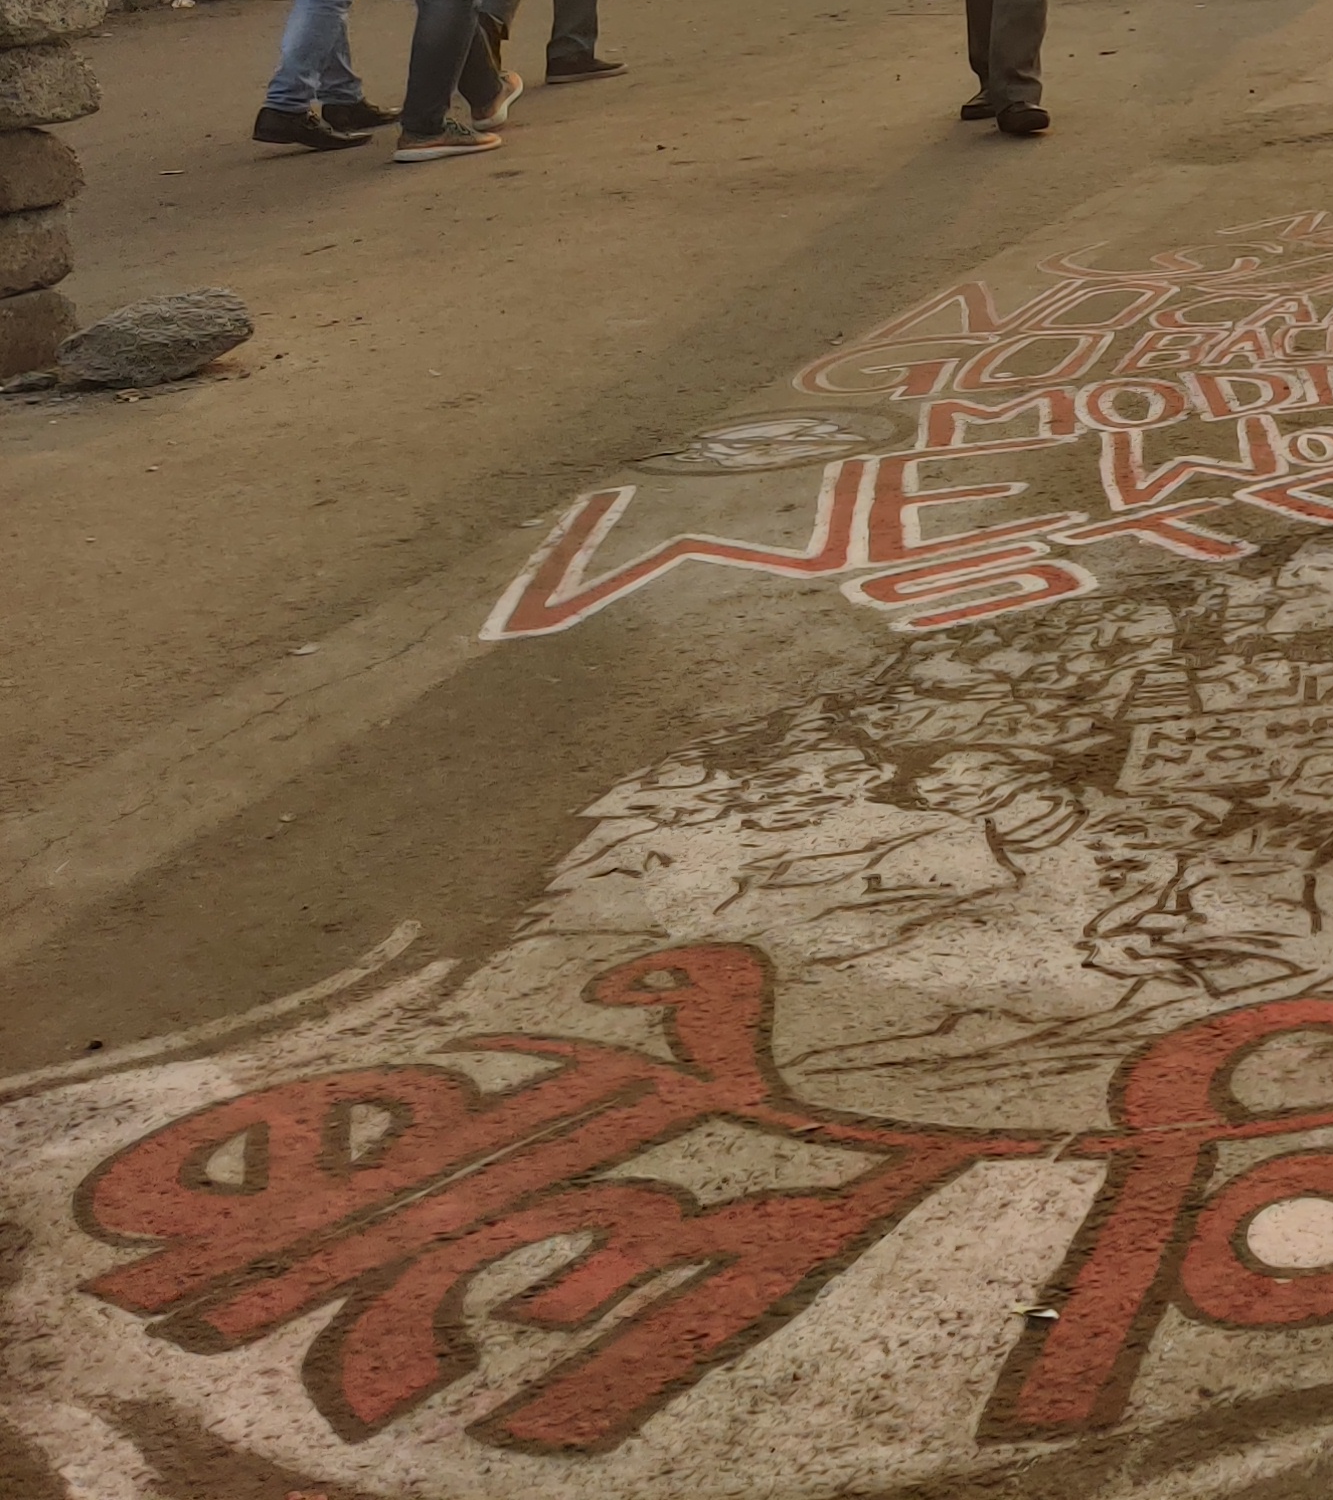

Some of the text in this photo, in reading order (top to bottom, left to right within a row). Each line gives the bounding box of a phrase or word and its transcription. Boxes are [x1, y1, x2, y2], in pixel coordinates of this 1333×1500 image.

[866, 279, 1180, 344] NO
[792, 330, 1114, 399] GO
[478, 434, 1091, 641] WE
[1141, 742, 1264, 771] NO
[74, 941, 1045, 1453] बोल
